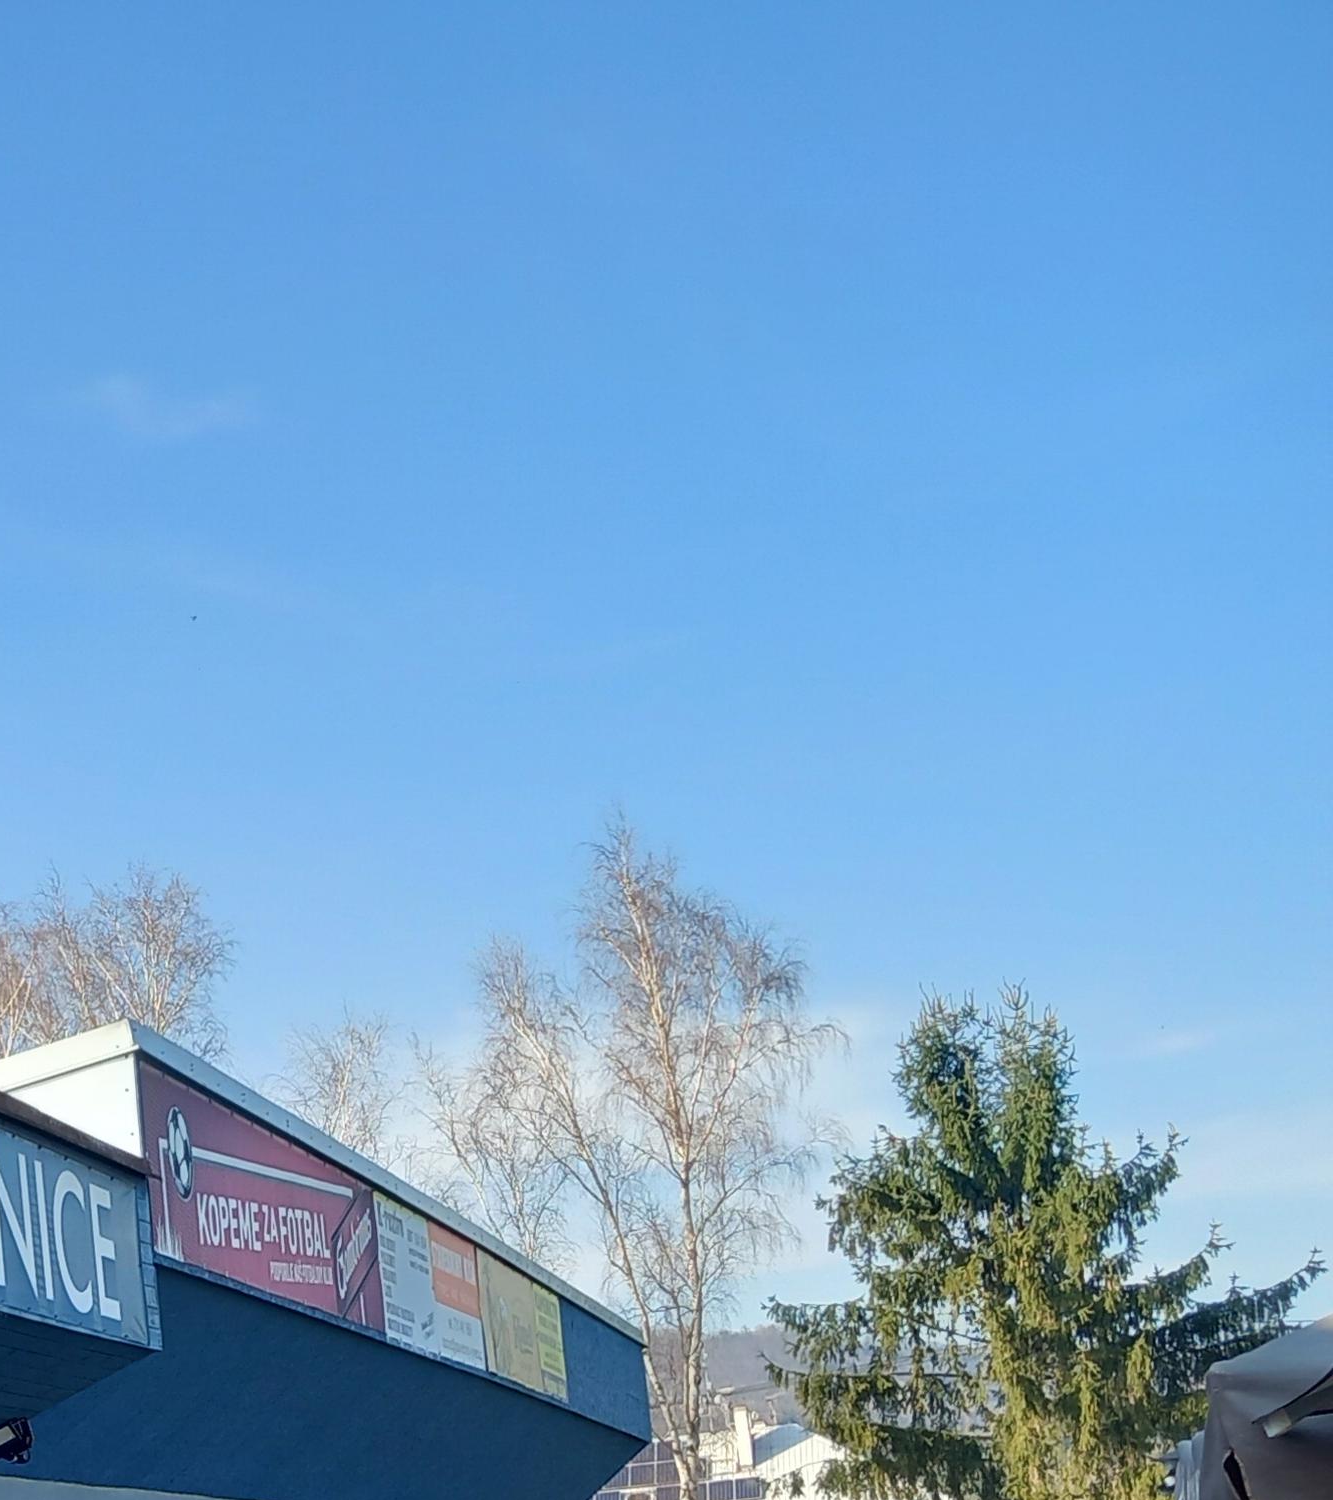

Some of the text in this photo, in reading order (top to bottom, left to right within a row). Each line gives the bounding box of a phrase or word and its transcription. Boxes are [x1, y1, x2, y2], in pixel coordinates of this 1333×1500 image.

[196, 1192, 262, 1251] KOPEME
[262, 1205, 279, 1243] ZA
[278, 1207, 331, 1259] FOTBAL
